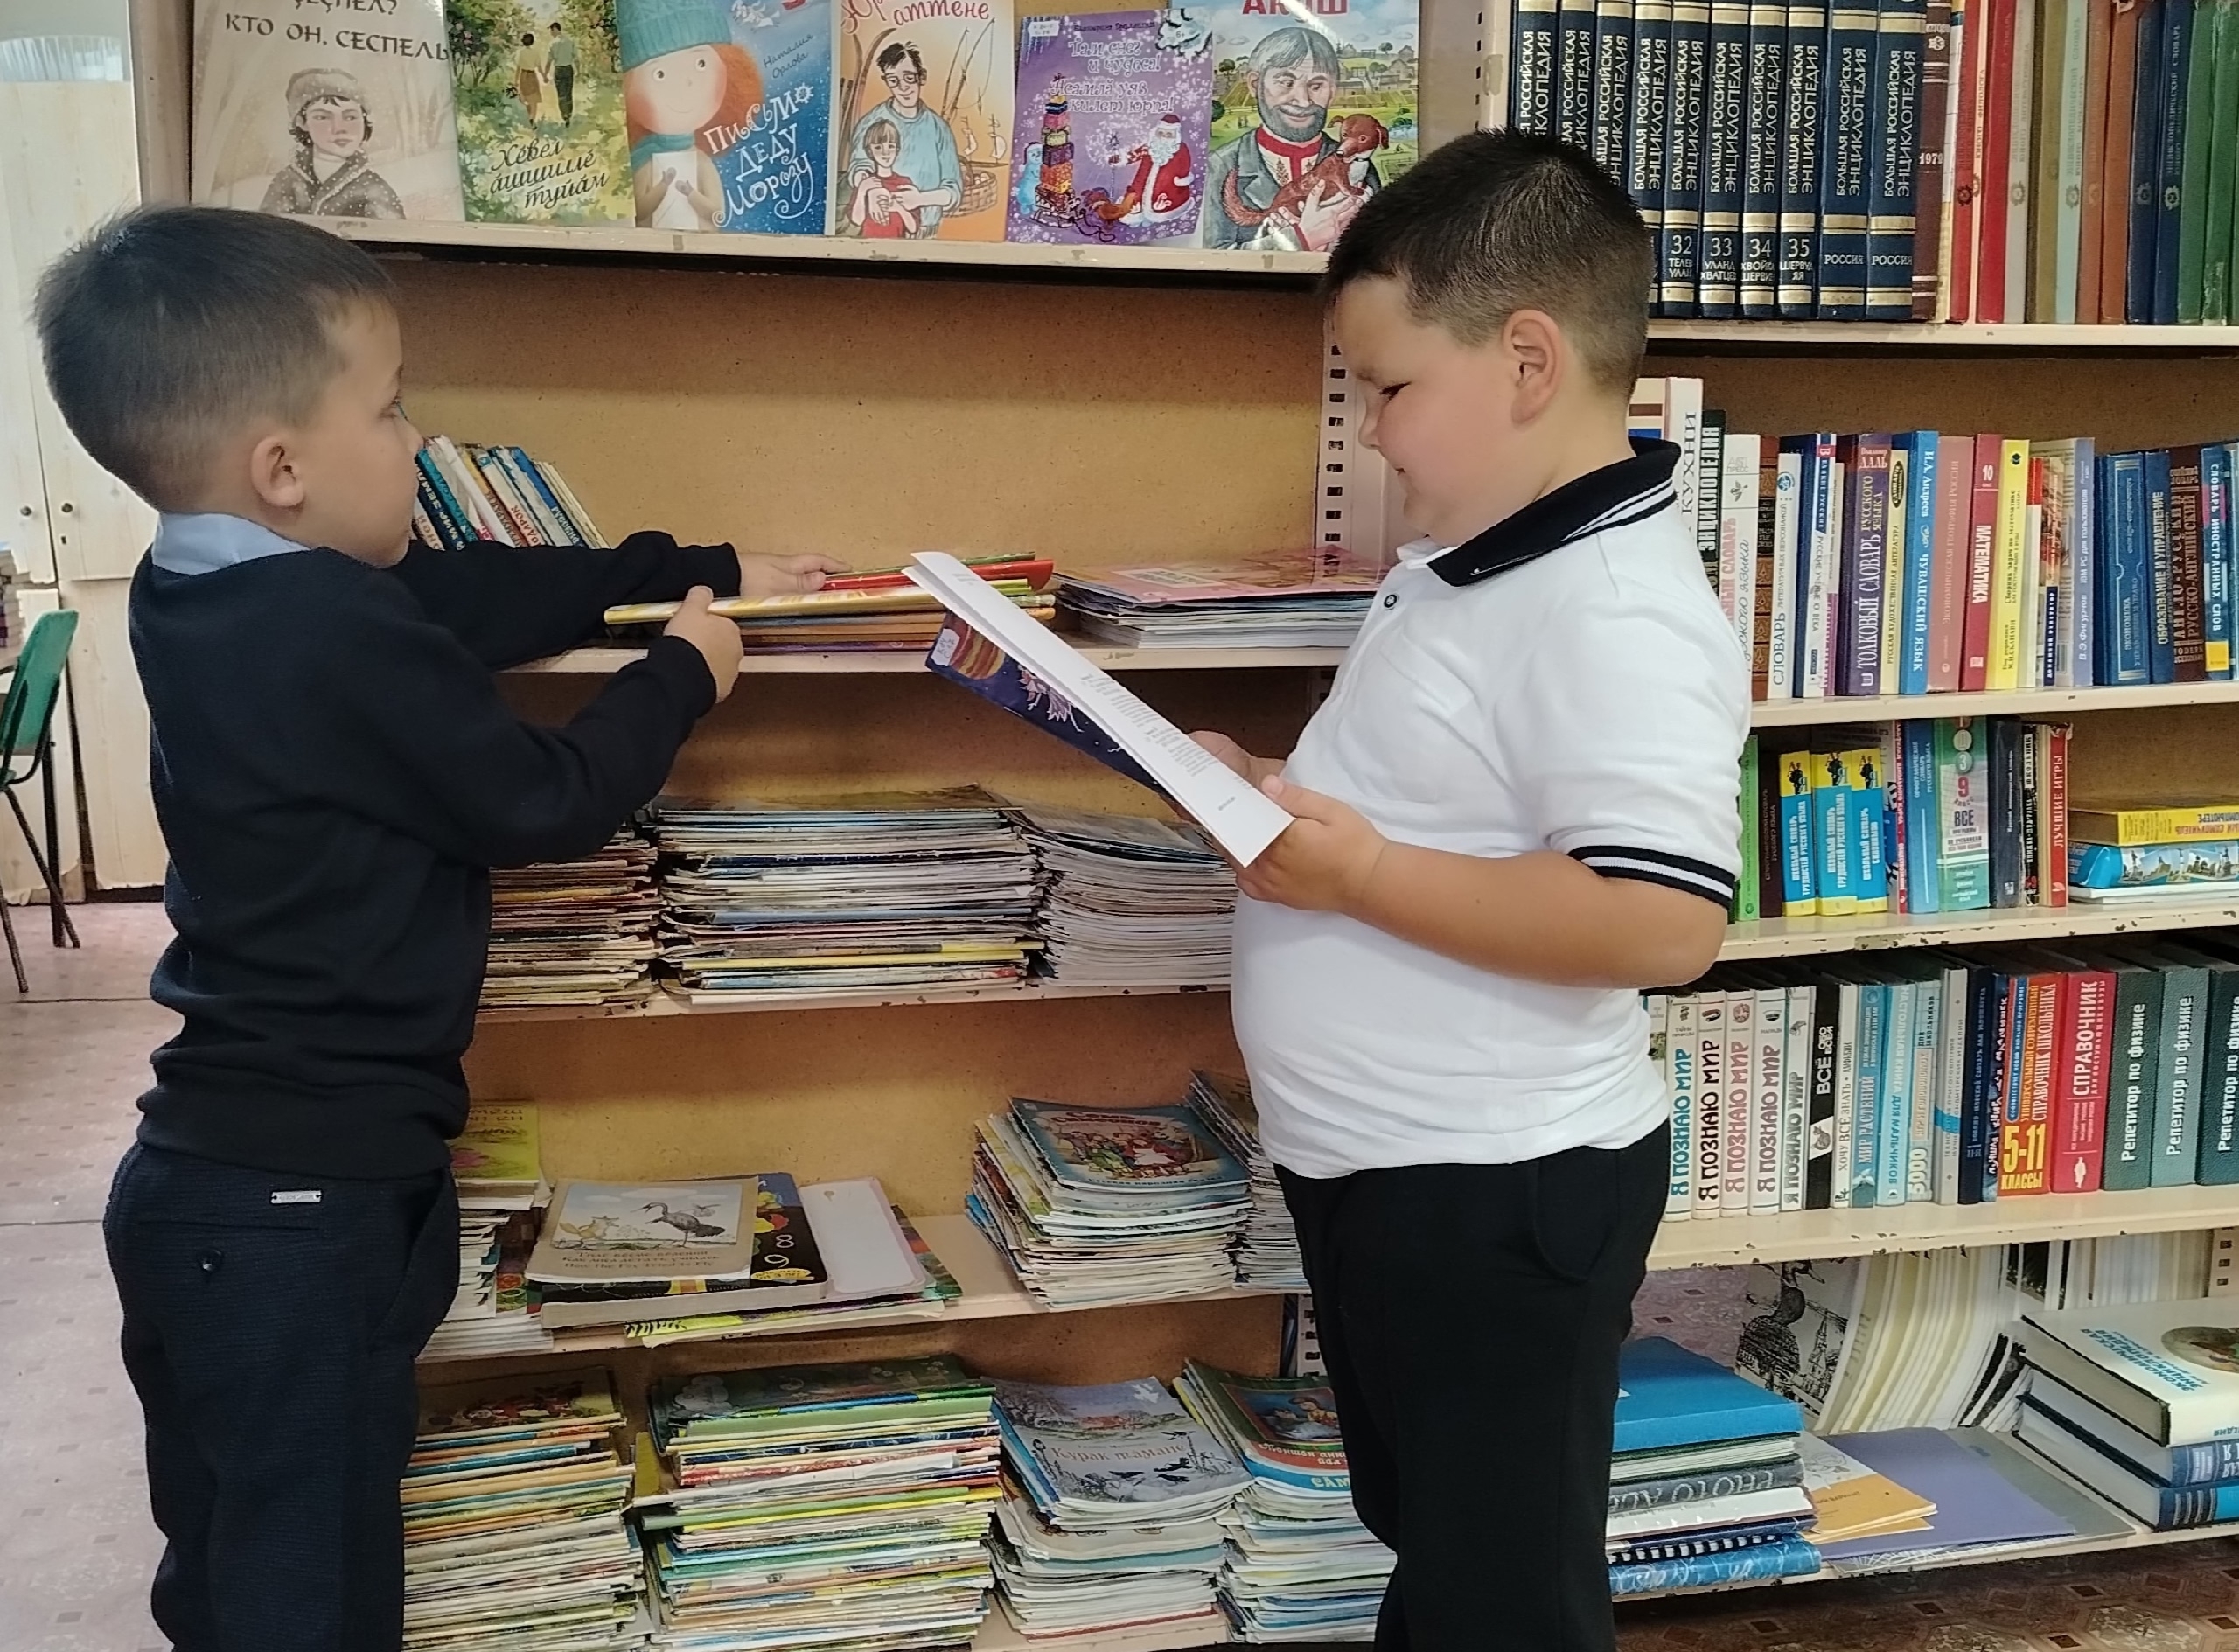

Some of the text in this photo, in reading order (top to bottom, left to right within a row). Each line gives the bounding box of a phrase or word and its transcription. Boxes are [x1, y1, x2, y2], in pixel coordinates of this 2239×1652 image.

[225, 13, 274, 36] КТО
[336, 30, 449, 60] СЕСПЕЛЬ
[1243, 0, 1347, 15] АКШ
[772, 52, 808, 79] Орлова
[1069, 40, 1103, 57] Там
[1088, 54, 1161, 76] и чудеса!
[1519, 31, 1535, 120] РОССИЙСКАЯ
[1562, 30, 1577, 117] РОССИЙСКАЯ
[1634, 38, 1652, 191] БОЛЬШАЯ РОССИЙСКАЯ
[1649, 38, 1668, 191] ЭНЦИКЛОПЕДИЯ
[1671, 40, 1689, 191] БОЛЬШАЯ РОССИЙСКАЯ
[1685, 40, 1705, 191] ЭНЦИКЛОПЕДИЯ
[1710, 42, 1727, 193] БОЛЬШАЯ РОССИЙСКАЯ
[1725, 42, 1744, 193] ЭНЦИКЛОПЕДИЯ
[1749, 44, 1767, 194] БОЛЬШАЯ РОССИЙСКАЯ
[1763, 44, 1782, 194] ЭНЦИКЛОПЕДИЯ
[1788, 45, 1804, 194] БОЛЬШАЯ РОССИЙСКАЯ
[1801, 45, 1820, 194] ЭНЦИКЛОПЕДИЯ
[1836, 47, 1852, 197] БОЛЬШАЯ РОССИЙСКАЯ
[1849, 48, 1867, 197] ЭНЦИКЛОПЕДИЯ
[1884, 50, 1901, 198] БОЛЬШАЯ РОССИЙСКАЯ
[1897, 51, 1917, 198] ЭНЦИКЛОПЕДИЯ
[1671, 235, 1692, 254] 32
[1710, 238, 1732, 257] 33
[1749, 238, 1772, 258] 34
[1788, 238, 1810, 258] 35
[1824, 254, 1864, 265] РОССИЯ
[1681, 412, 1697, 515] КУХНИ
[1698, 426, 1720, 551] ЭНЦИКЛОПЕДИЯ
[1859, 456, 1887, 469] ДАЛЬ
[1982, 465, 1993, 481] 10
[439, 511, 459, 540] МИР
[1721, 517, 1736, 575] СЛОВАРЬ
[1873, 491, 1883, 531] ЯЗЫКА
[2082, 488, 2090, 539] пользователя
[2152, 491, 2165, 562] УПРАВЛЕНИЕ
[1856, 475, 1880, 669] ТОЛКОВЫЙ СЛОВАРЬ РУССКОГО
[1891, 525, 1900, 569] ЛИТЕРАТУРА
[1971, 525, 1991, 604] МАТЕМАТИКА
[2209, 464, 2222, 632] СЛОВАРЬ ИНОСТРАННЫХ СЛОВ
[1771, 612, 1786, 687] СЛОВАРЬ
[1779, 503, 1788, 554] ПЕРСОНАЖЕЙ
[1888, 571, 1897, 633] ХУДОЖЕСТВЕННАЯ
[1915, 554, 1930, 631] ЧУВАШСКИЙ
[2078, 594, 2089, 660] В.Э.Фигурнов
[2153, 575, 2168, 645] ОБРАЗОВАНИЕ
[1913, 637, 1925, 672] ЯЗЫК
[1798, 800, 1807, 823] ЯЗЫКА
[1835, 793, 1845, 815] ЯЗЫКА
[1954, 810, 1974, 827] ВСЕ
[1957, 777, 1970, 797] 9
[2053, 755, 2064, 848] ЛУЧШИЕ ИГРЫ
[1789, 815, 1799, 882] ШКОЛЬНЫЙ СЛОВАРЬ
[1825, 807, 1837, 873] ШКОЛЬНЫЙ СЛОВАРЬ
[1836, 848, 1847, 889] ТРУДНОСТЕЙ
[1859, 808, 1871, 881] ШКОЛЬНЫЙ СЛОВАРЬ
[1799, 856, 1811, 896] ТРУДНОСТЕЙ
[1925, 995, 1935, 1047] ШКОЛЬНИКОВ
[2020, 985, 2039, 1122] УНИВЕРСАЛЬНЫЙ СОВРЕМЕННЫЙ
[2031, 984, 2057, 1121] СПРАВОЧНИК ШКОЛЬНИКА
[2073, 980, 2098, 1096] СПРАВОЧНИК
[1888, 986, 1910, 1184] НАСТОЛЬНАЯ КНИГА ДЛЯ МАЛЬЧИКОВ
[2121, 1003, 2145, 1162] Репетитор по физике
[2166, 995, 2193, 1156] Репетитор по физике
[2225, 1054, 2238, 1071] по
[1671, 1047, 1693, 1196] Я ПОЗНАЮ МИР
[1698, 1039, 1721, 1202] Я ПОЗНАЮ МИР
[1725, 1041, 1749, 1193] Я ПОЗНАЮ МИР
[1757, 1044, 1781, 1193] Я ПОЗНАЮ МИР
[1840, 1084, 1852, 1115] ЗНАТЬ
[1858, 1076, 1876, 1164] МИР РАСТЕНИЙ
[2218, 1077, 2238, 1152] Репетитор
[1783, 1071, 1804, 1205] Я ПОЗНАЮ МИР
[1838, 1144, 1849, 1172] ХОЧУ
[1908, 1147, 1929, 1195] 5000
[2003, 1123, 2046, 1172] 5-11
[2001, 1172, 2043, 1190] КЛАССЫ
[764, 1254, 790, 1268] 9
[775, 1234, 793, 1249] 8
[1671, 1470, 1775, 1503] PHOTO
